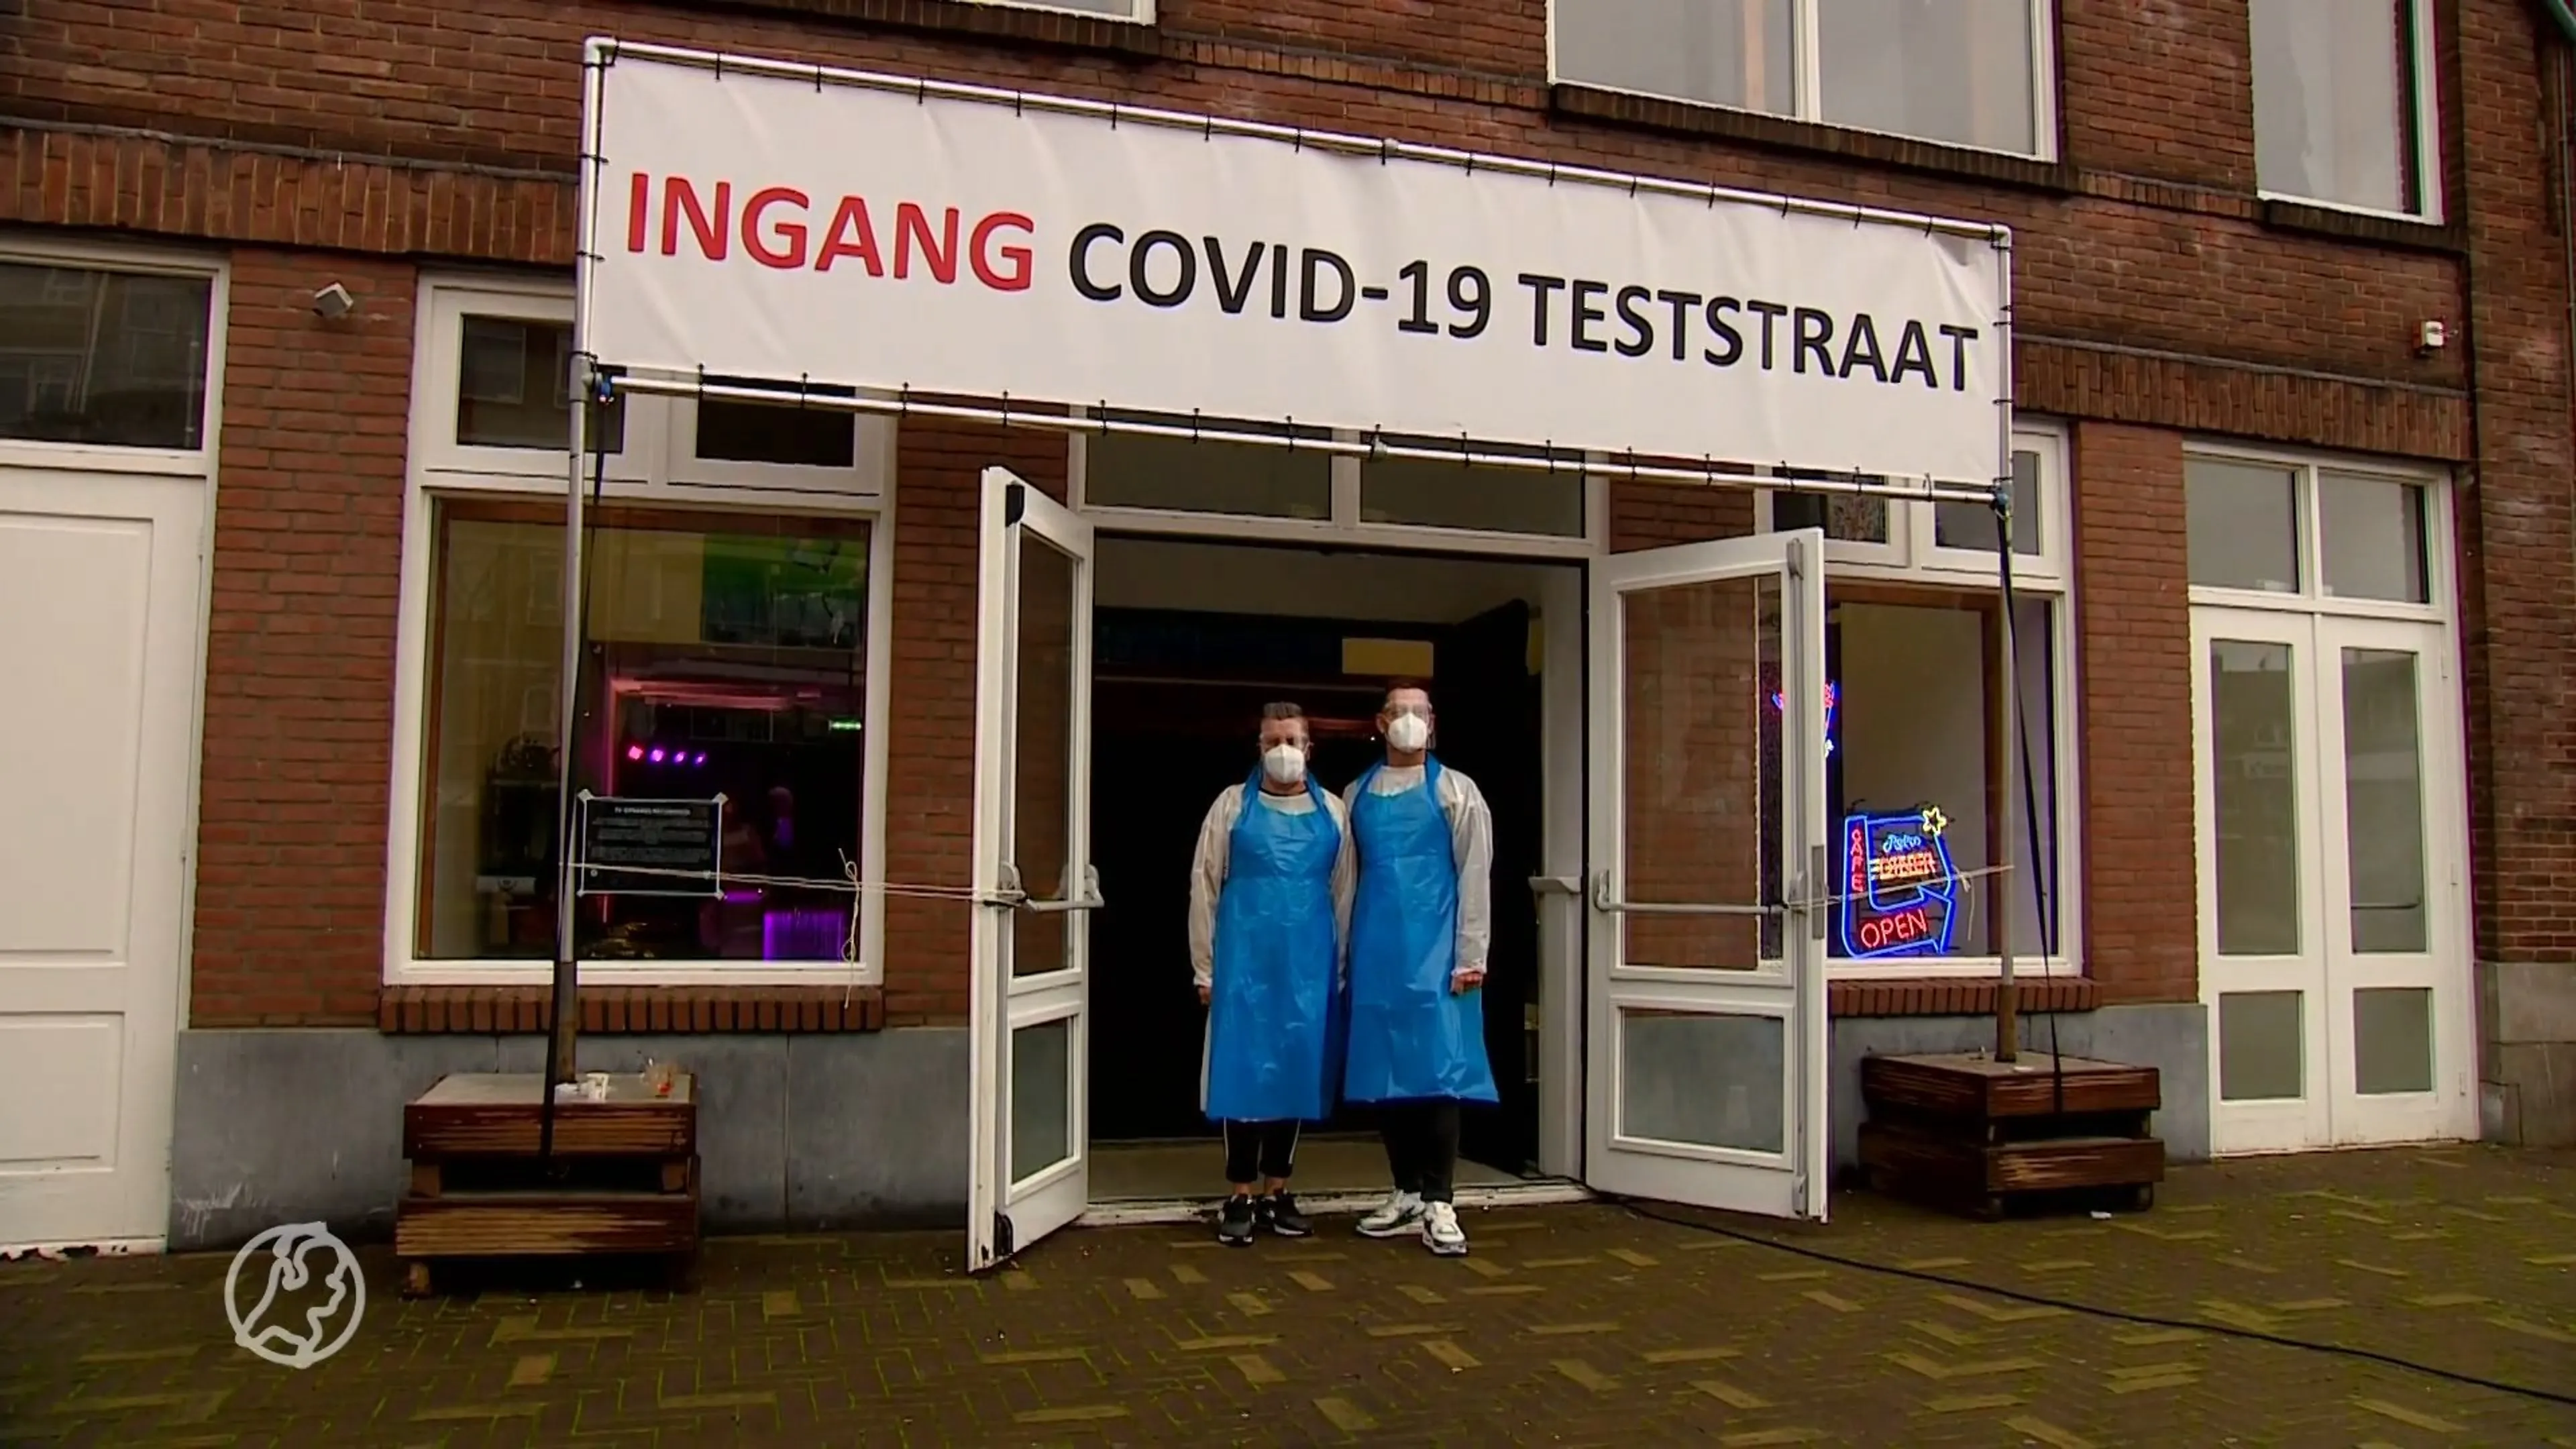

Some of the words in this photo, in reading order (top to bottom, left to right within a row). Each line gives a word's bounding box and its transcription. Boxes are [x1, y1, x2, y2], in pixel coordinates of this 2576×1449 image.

[628, 172, 1034, 292] INGANG
[1069, 222, 1491, 339] COVID-19
[1517, 273, 1979, 392] TESTSTRAAT
[1860, 908, 1927, 949] OPEN
